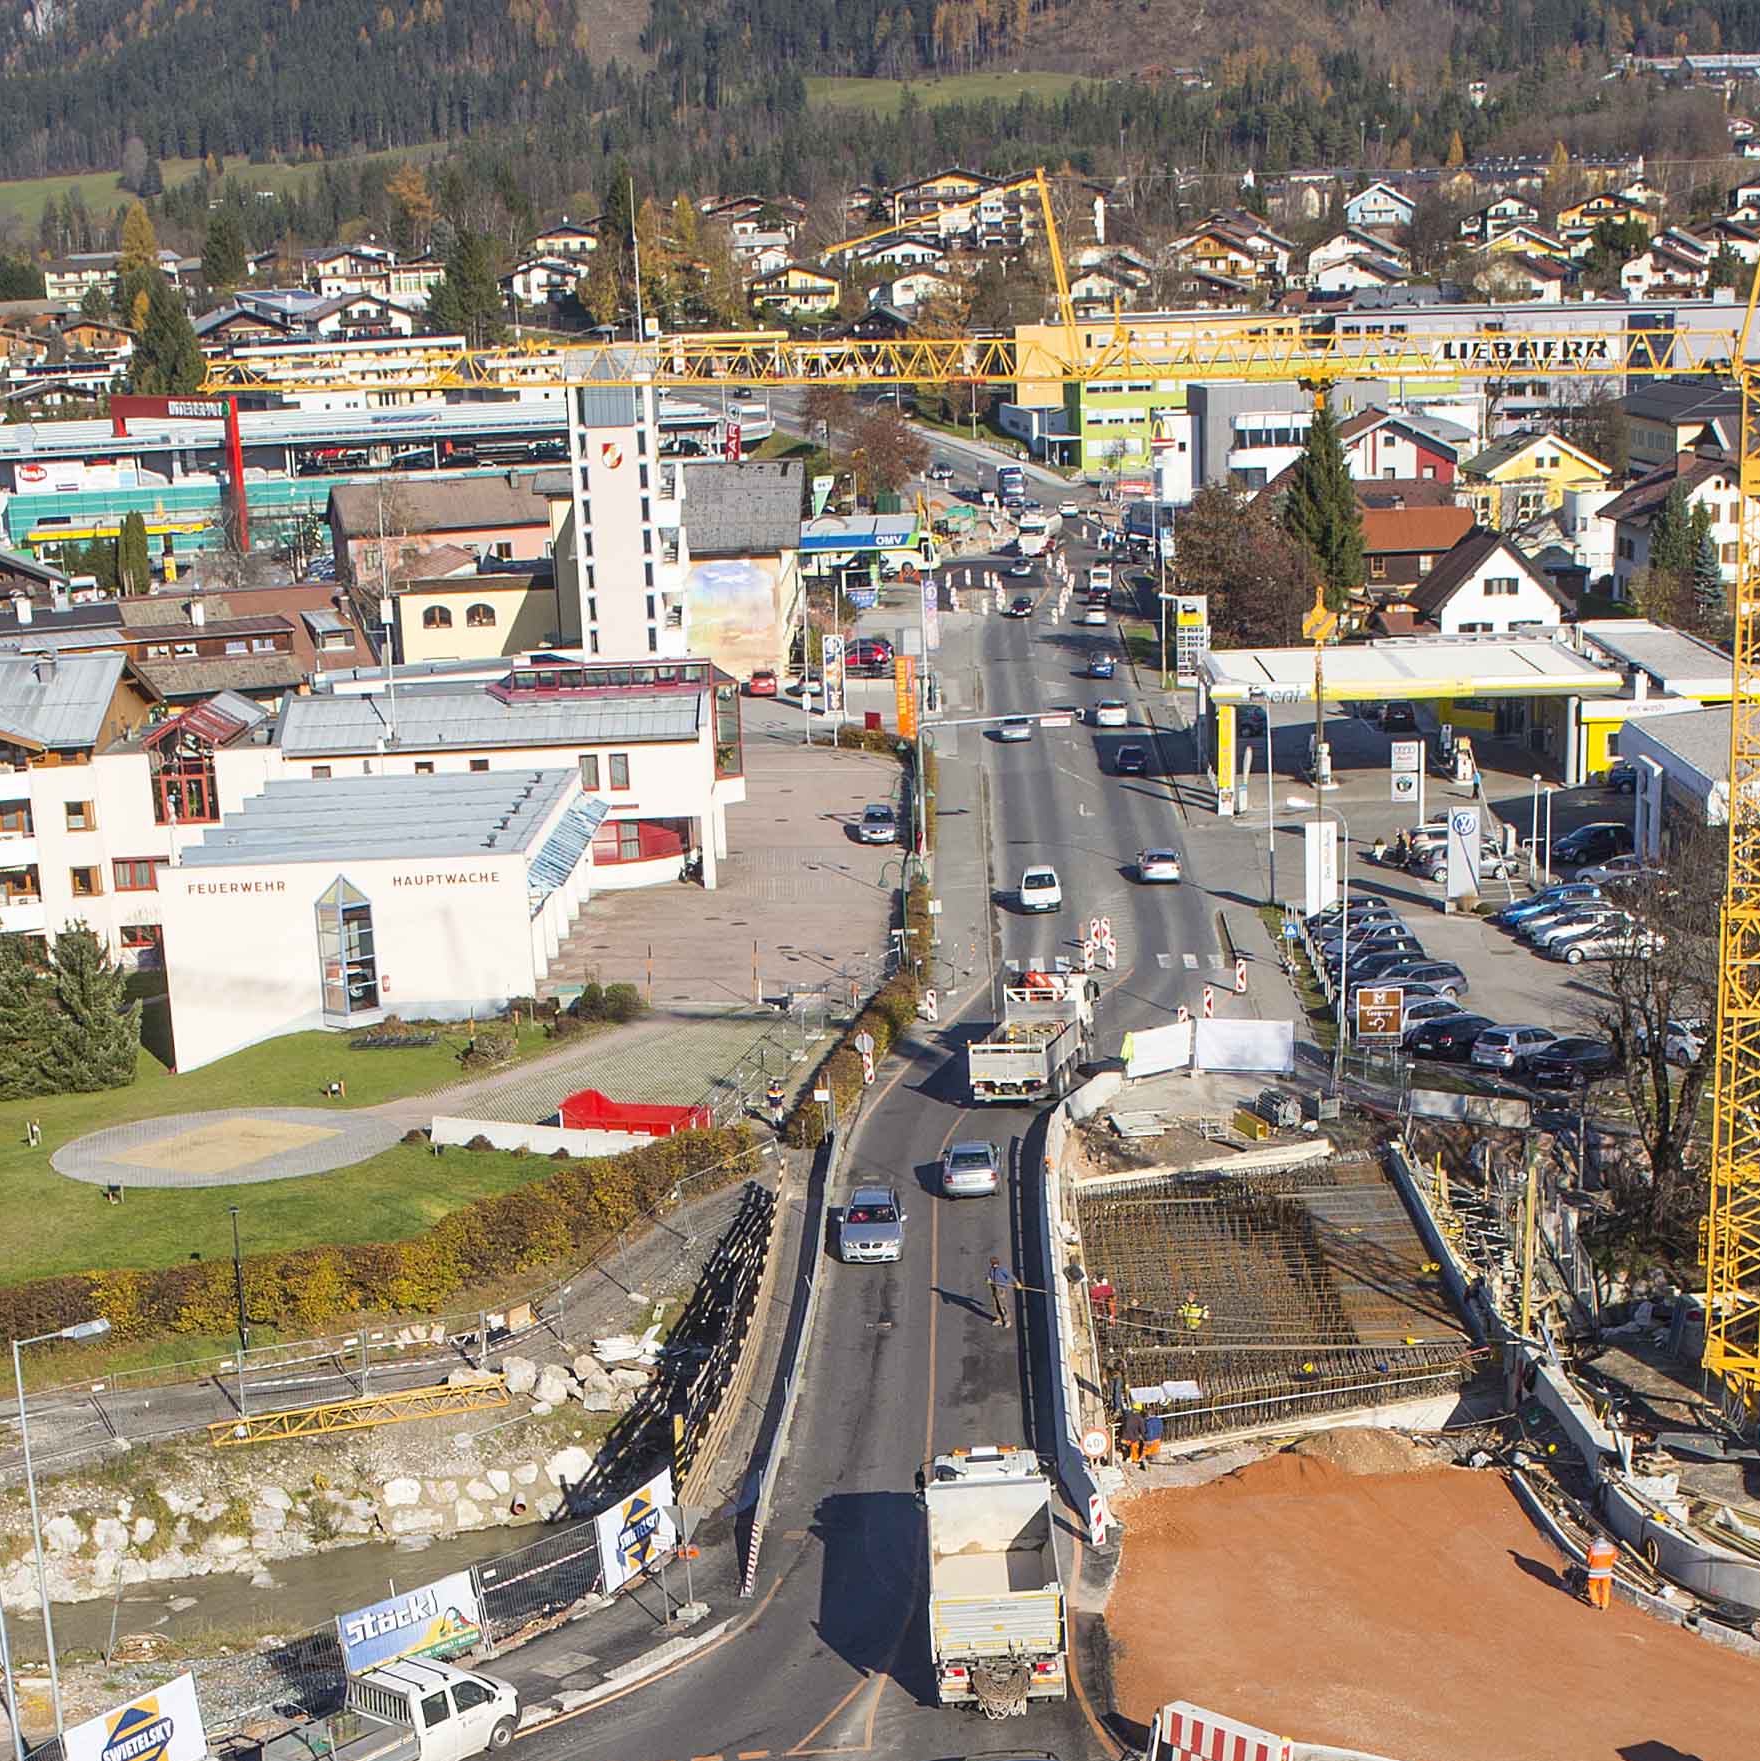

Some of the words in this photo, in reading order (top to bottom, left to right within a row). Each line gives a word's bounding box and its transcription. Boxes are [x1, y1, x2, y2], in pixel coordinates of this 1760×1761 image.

[1442, 339, 1608, 361] LIEBHERR
[875, 535, 903, 546] OMV
[187, 880, 287, 896] FEUERWEHR
[392, 872, 501, 888] HAUPTWACHE
